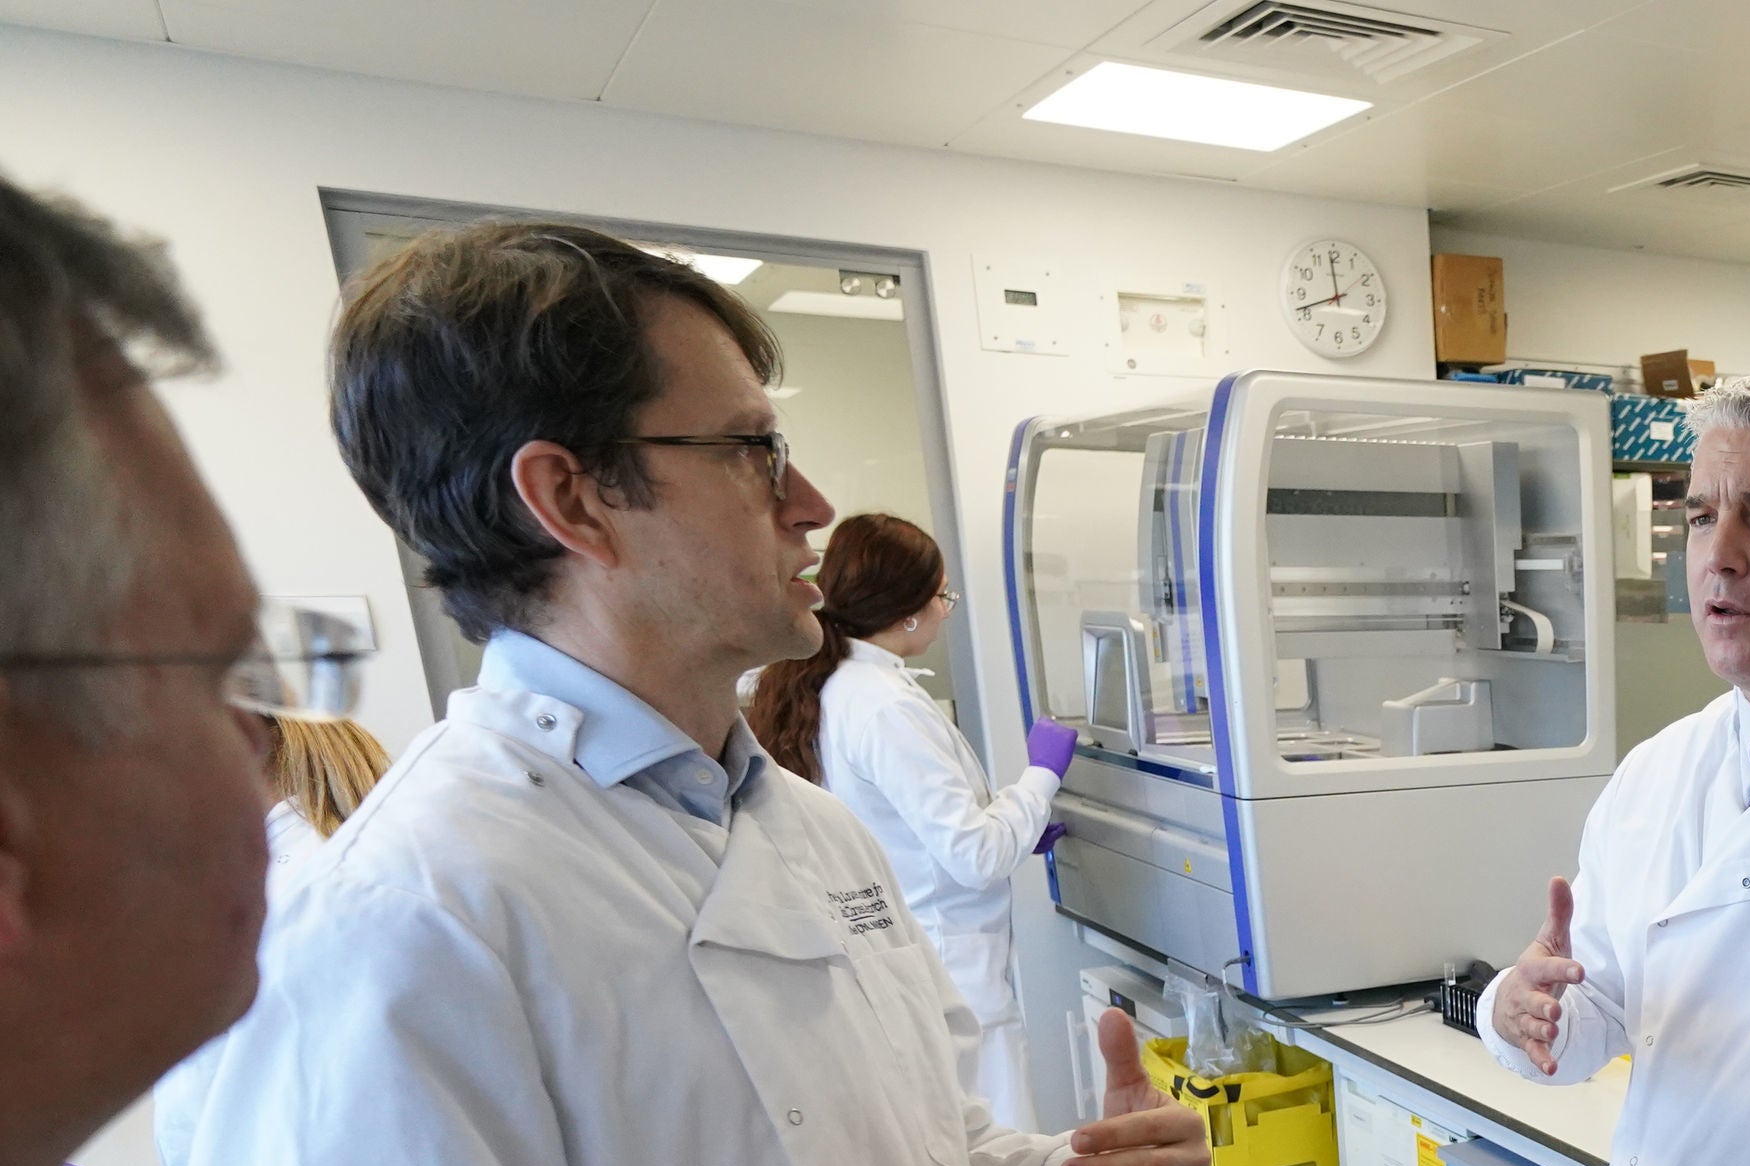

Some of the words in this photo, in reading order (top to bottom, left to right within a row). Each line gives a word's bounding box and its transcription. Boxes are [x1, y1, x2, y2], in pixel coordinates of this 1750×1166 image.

[1312, 254, 1322, 267] 11
[1349, 258, 1355, 270] 1
[1299, 267, 1313, 281] 10
[1361, 273, 1370, 287] 2
[1297, 288, 1306, 300] 9
[1366, 294, 1375, 307] 3
[1303, 308, 1312, 321] 8
[1362, 314, 1371, 324] 4
[1316, 324, 1325, 337] 7
[1352, 327, 1360, 340] 5
[1334, 331, 1343, 344] 6
